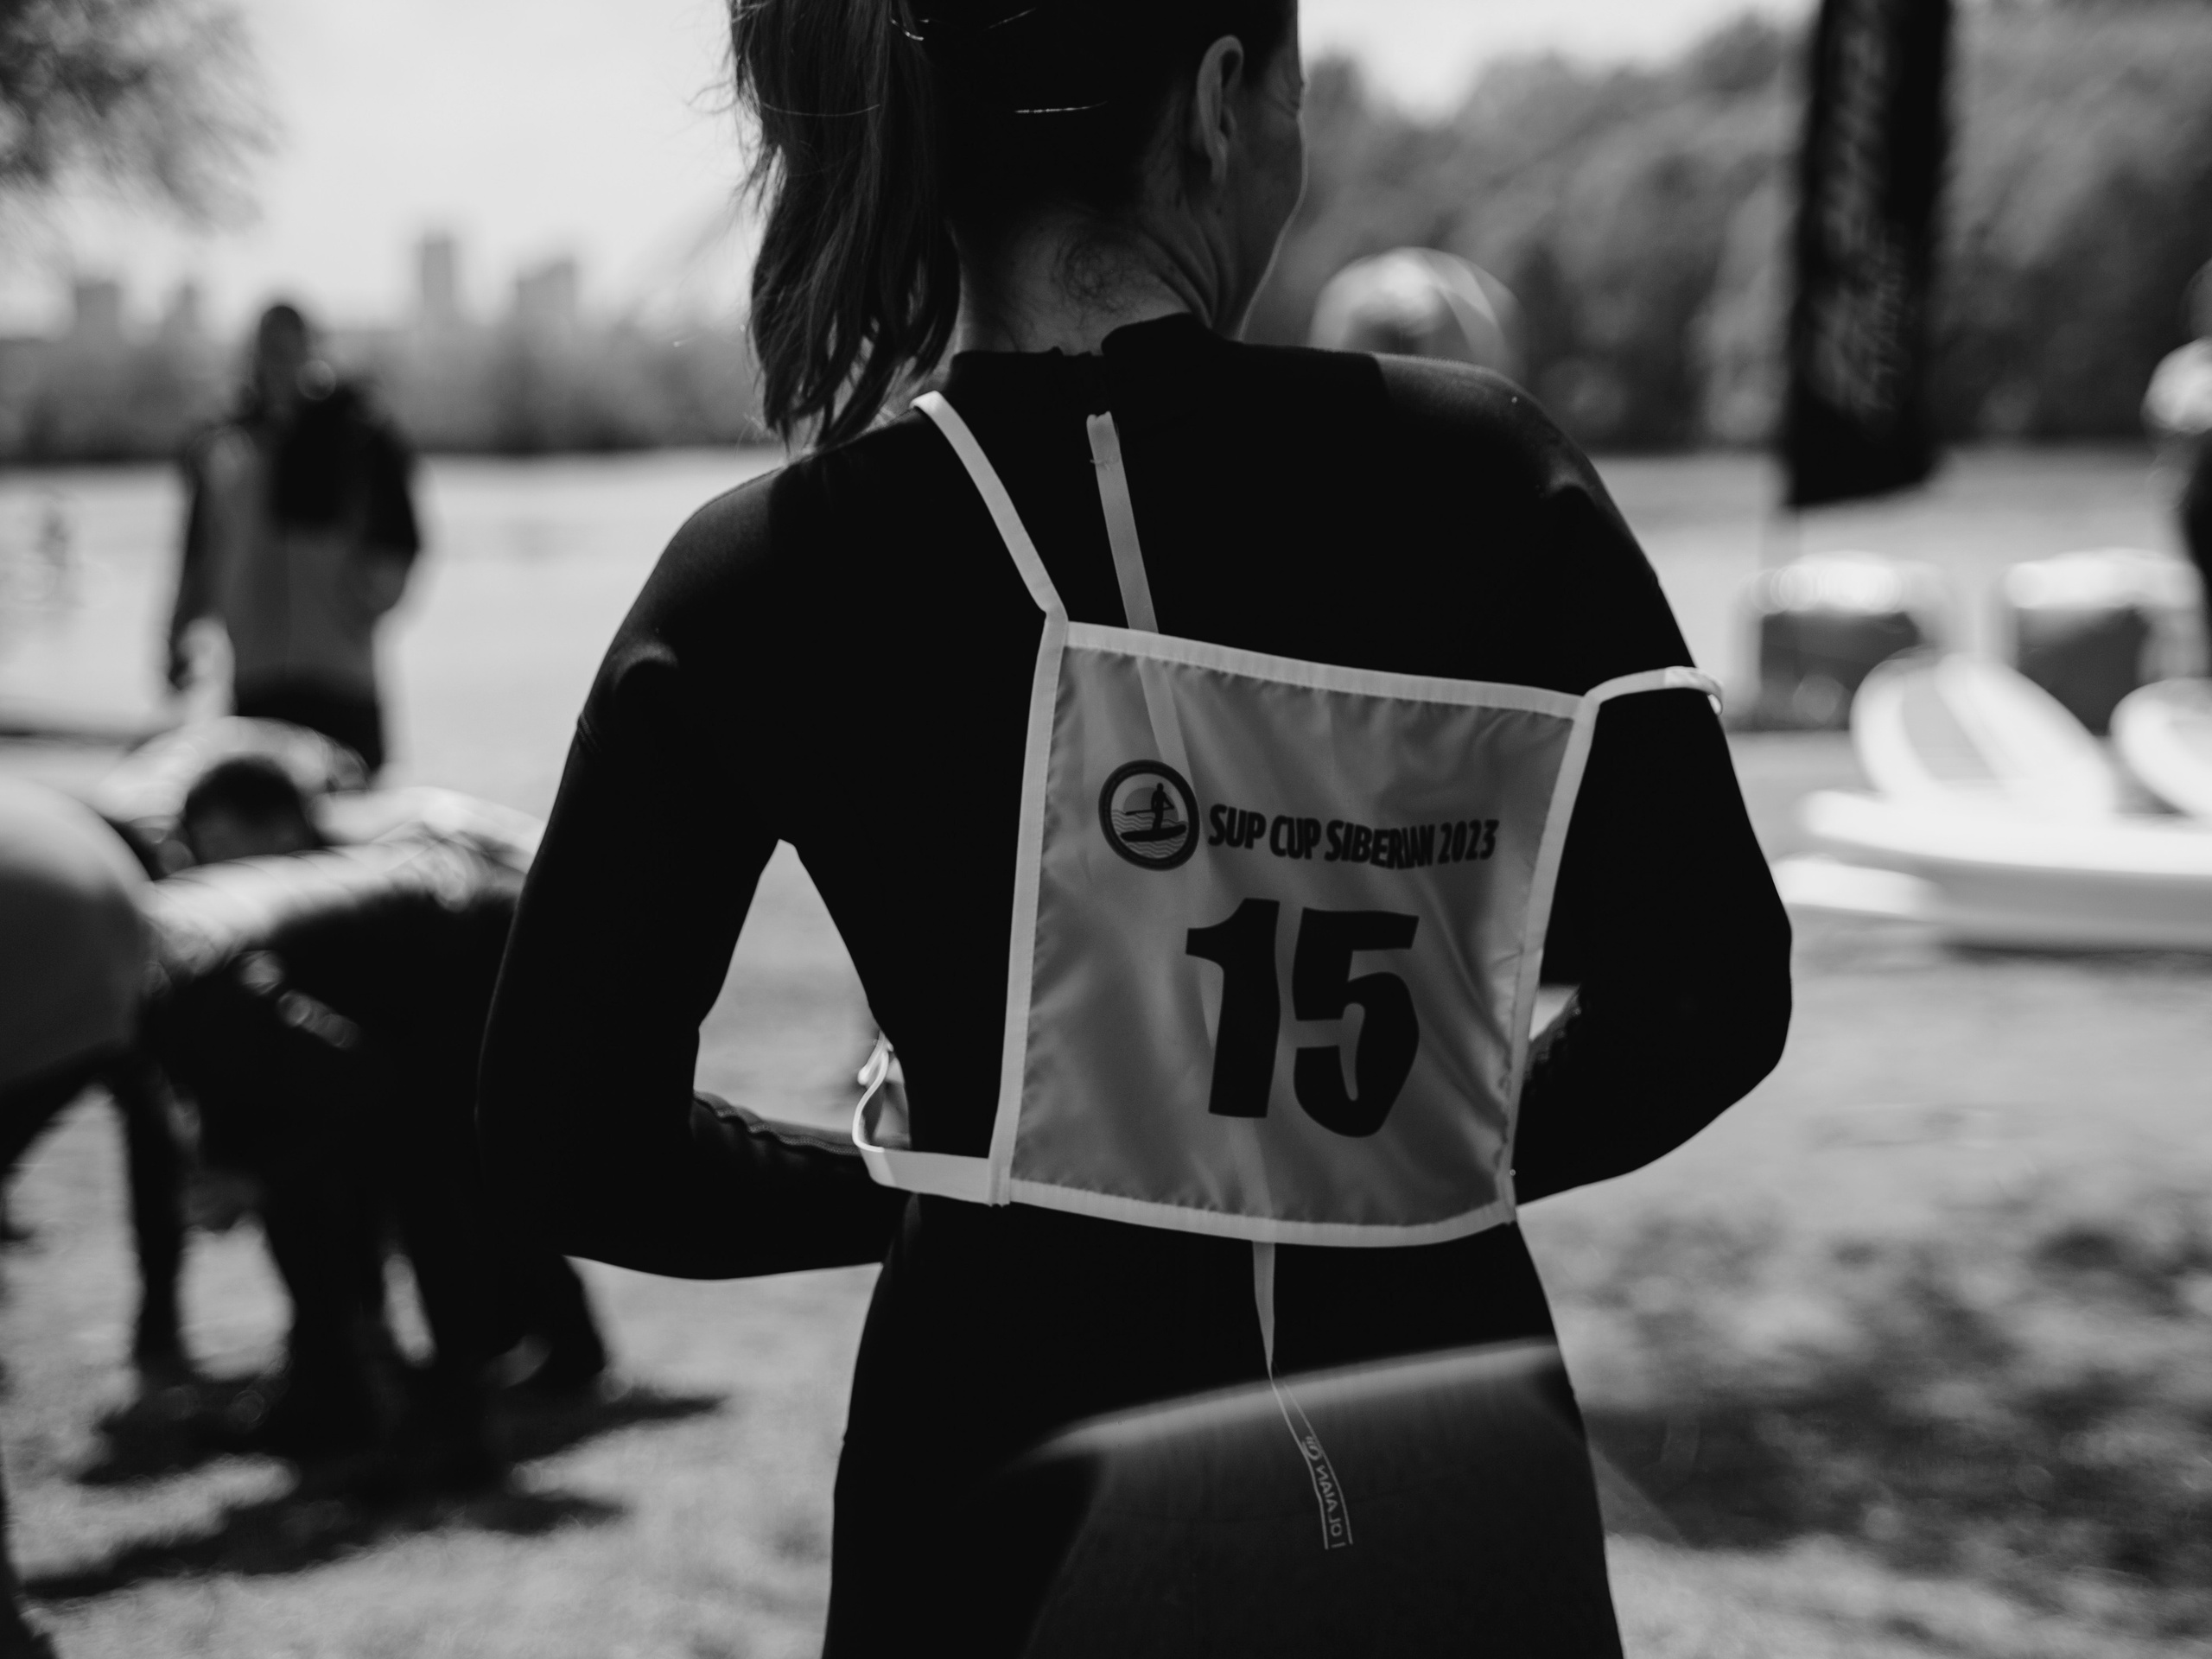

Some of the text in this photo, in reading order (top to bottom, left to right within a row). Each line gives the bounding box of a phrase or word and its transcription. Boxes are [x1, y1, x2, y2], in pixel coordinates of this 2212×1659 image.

[1208, 804, 1267, 849] SUP
[1269, 815, 1321, 860] CUP
[1324, 819, 1436, 869] SIBERIAN
[1437, 819, 1500, 864] 2023
[1185, 898, 1420, 1138] 15
